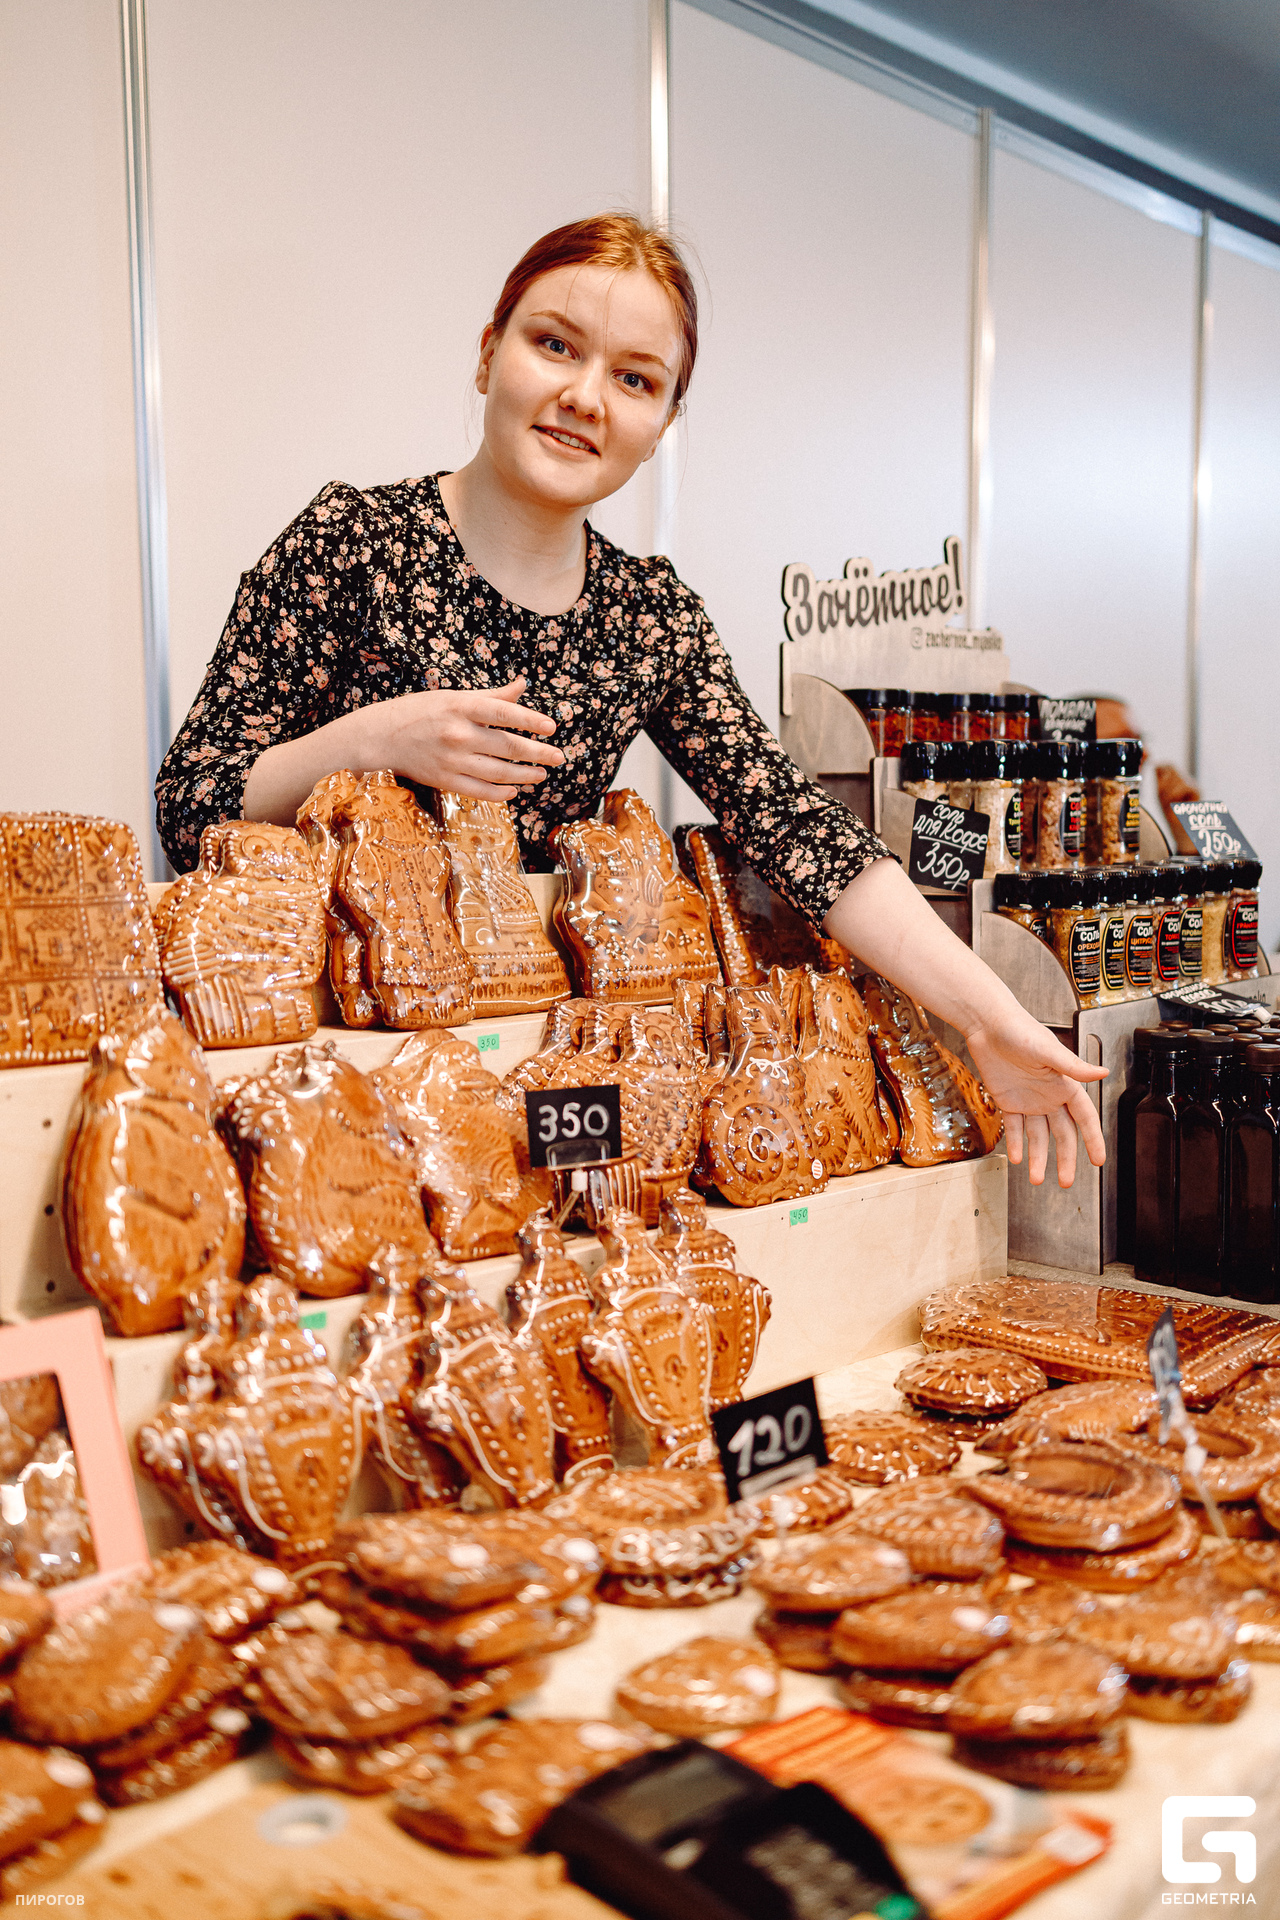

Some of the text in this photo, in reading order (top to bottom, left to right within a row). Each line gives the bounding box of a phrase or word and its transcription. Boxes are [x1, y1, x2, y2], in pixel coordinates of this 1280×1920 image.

[792, 543, 964, 636] Зачётное!
[480, 1038, 497, 1049] 350
[538, 1102, 610, 1143] 350
[727, 1404, 812, 1477] 120
